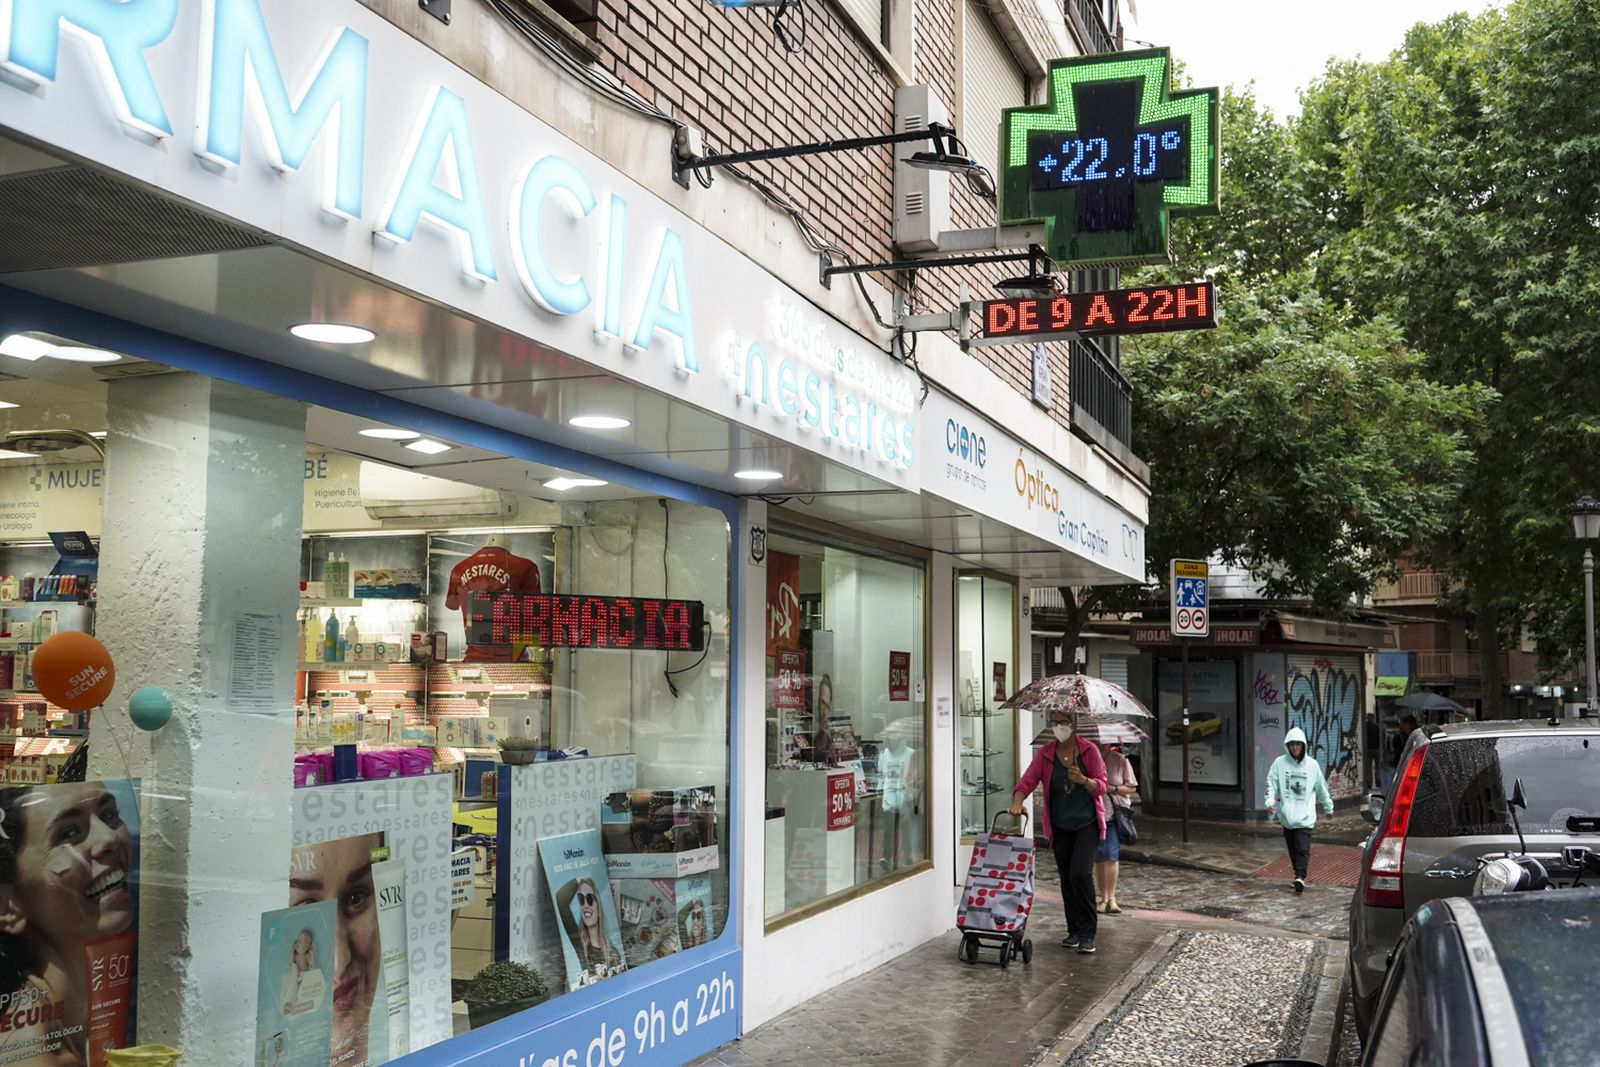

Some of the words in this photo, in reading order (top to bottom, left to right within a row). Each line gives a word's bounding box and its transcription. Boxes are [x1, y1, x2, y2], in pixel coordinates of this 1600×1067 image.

[989, 301, 1039, 333] DE
[1051, 298, 1072, 328] 9
[1085, 295, 1114, 326] A
[1128, 286, 1207, 322] 22H
[743, 340, 914, 470] nestares
[48, 468, 105, 489] MUJE
[1014, 448, 1060, 515] Óptica
[314, 488, 346, 498] Higiene
[1058, 510, 1079, 543] Gran
[461, 564, 511, 585] NESTARES
[1135, 628, 1170, 642] ¡HOLA!
[1216, 628, 1254, 642] ¡HOLA!
[782, 653, 800, 664] OFERTA
[65, 666, 108, 699] SECURE
[69, 665, 96, 687] SUN
[779, 695, 800, 703] VERANO
[290, 851, 317, 873] SVR
[379, 885, 403, 909] SVR
[92, 956, 105, 992] SVR
[586, 1022, 626, 1067] de
[634, 1001, 666, 1055] 9h
[672, 998, 689, 1037] a
[696, 971, 735, 1027] 22h
[24, 1025, 84, 1047] DERMATOLÓGICA
